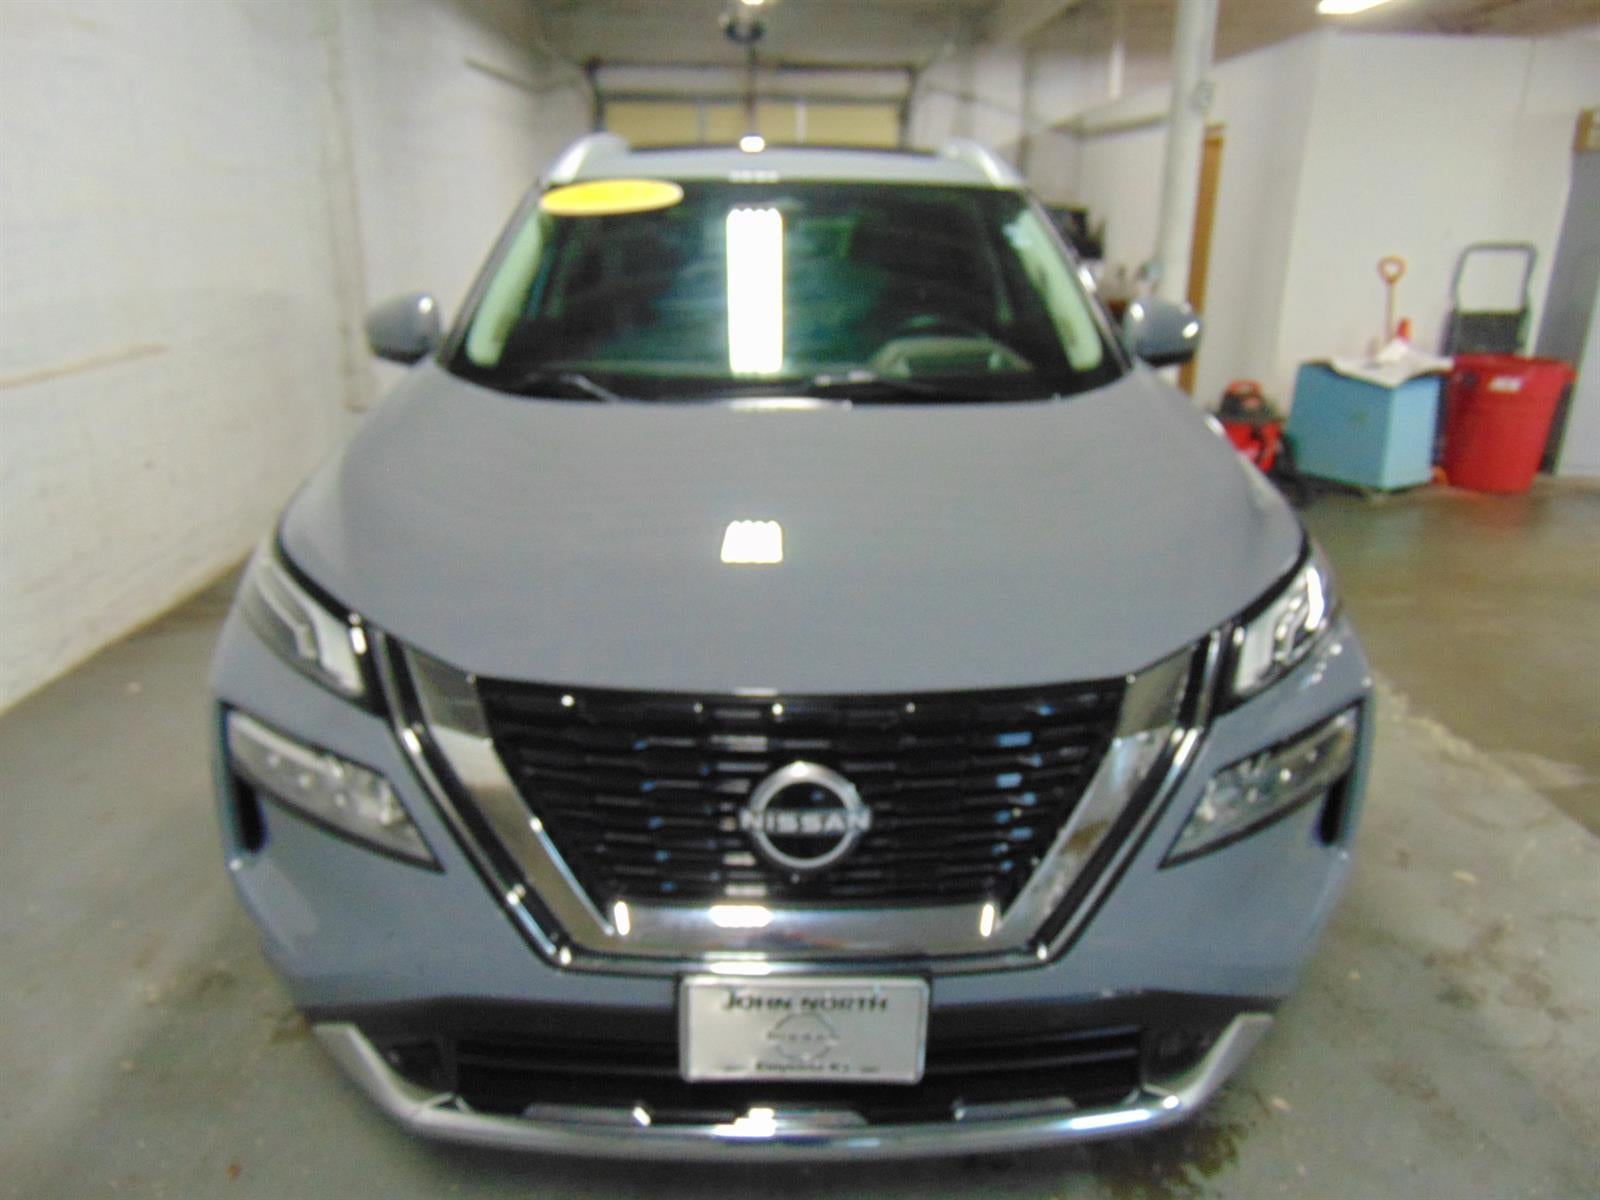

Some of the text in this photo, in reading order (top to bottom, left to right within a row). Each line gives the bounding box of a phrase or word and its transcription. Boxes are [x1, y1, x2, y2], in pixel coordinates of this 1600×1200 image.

[740, 809, 872, 834] NISSAN
[724, 990, 889, 1012] JOHN NORTH
